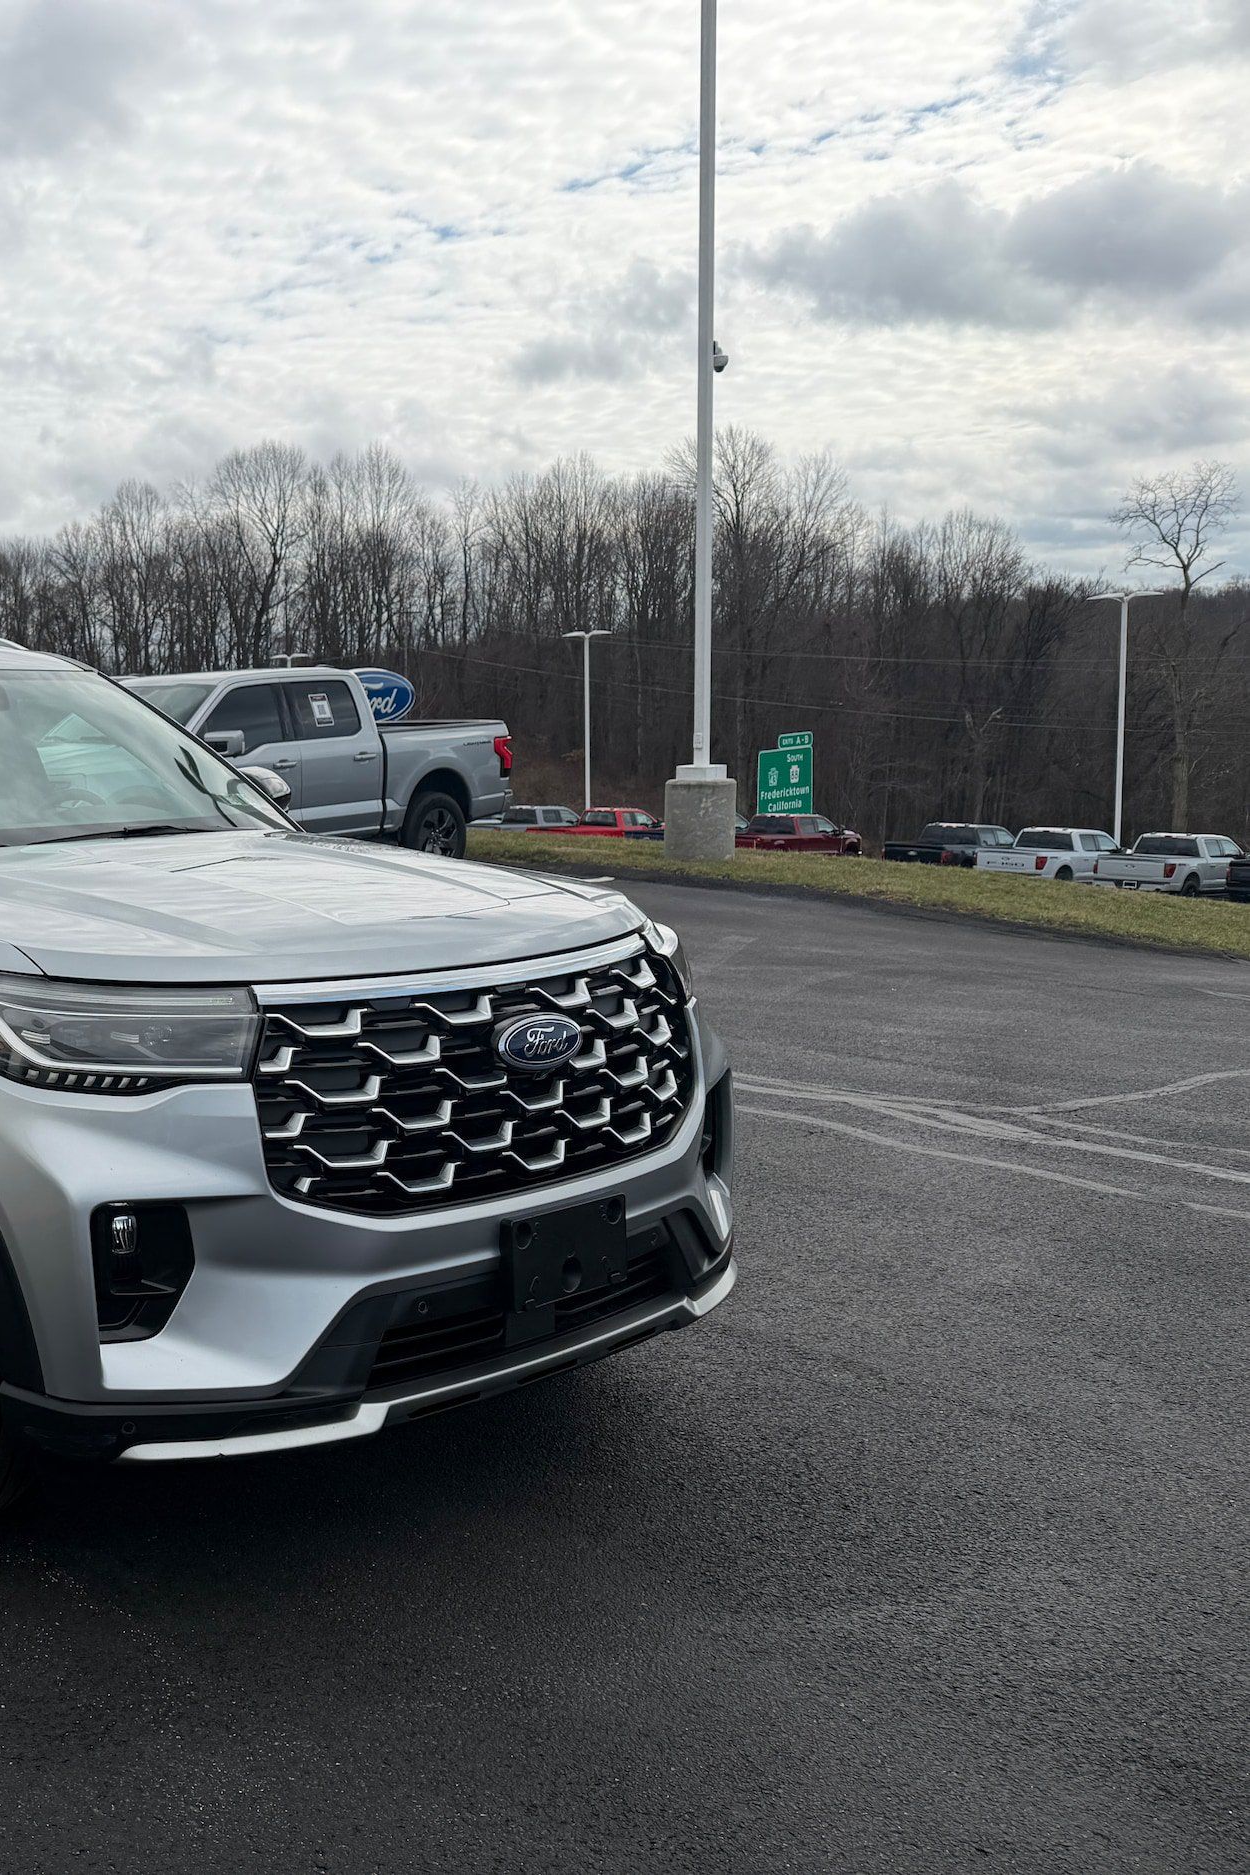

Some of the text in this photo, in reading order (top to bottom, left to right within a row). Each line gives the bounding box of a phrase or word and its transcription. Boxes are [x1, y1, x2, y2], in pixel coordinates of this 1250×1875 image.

[760, 785, 810, 800] Fredericktown
[767, 798, 803, 812] California
[523, 1026, 569, 1058] Ford
